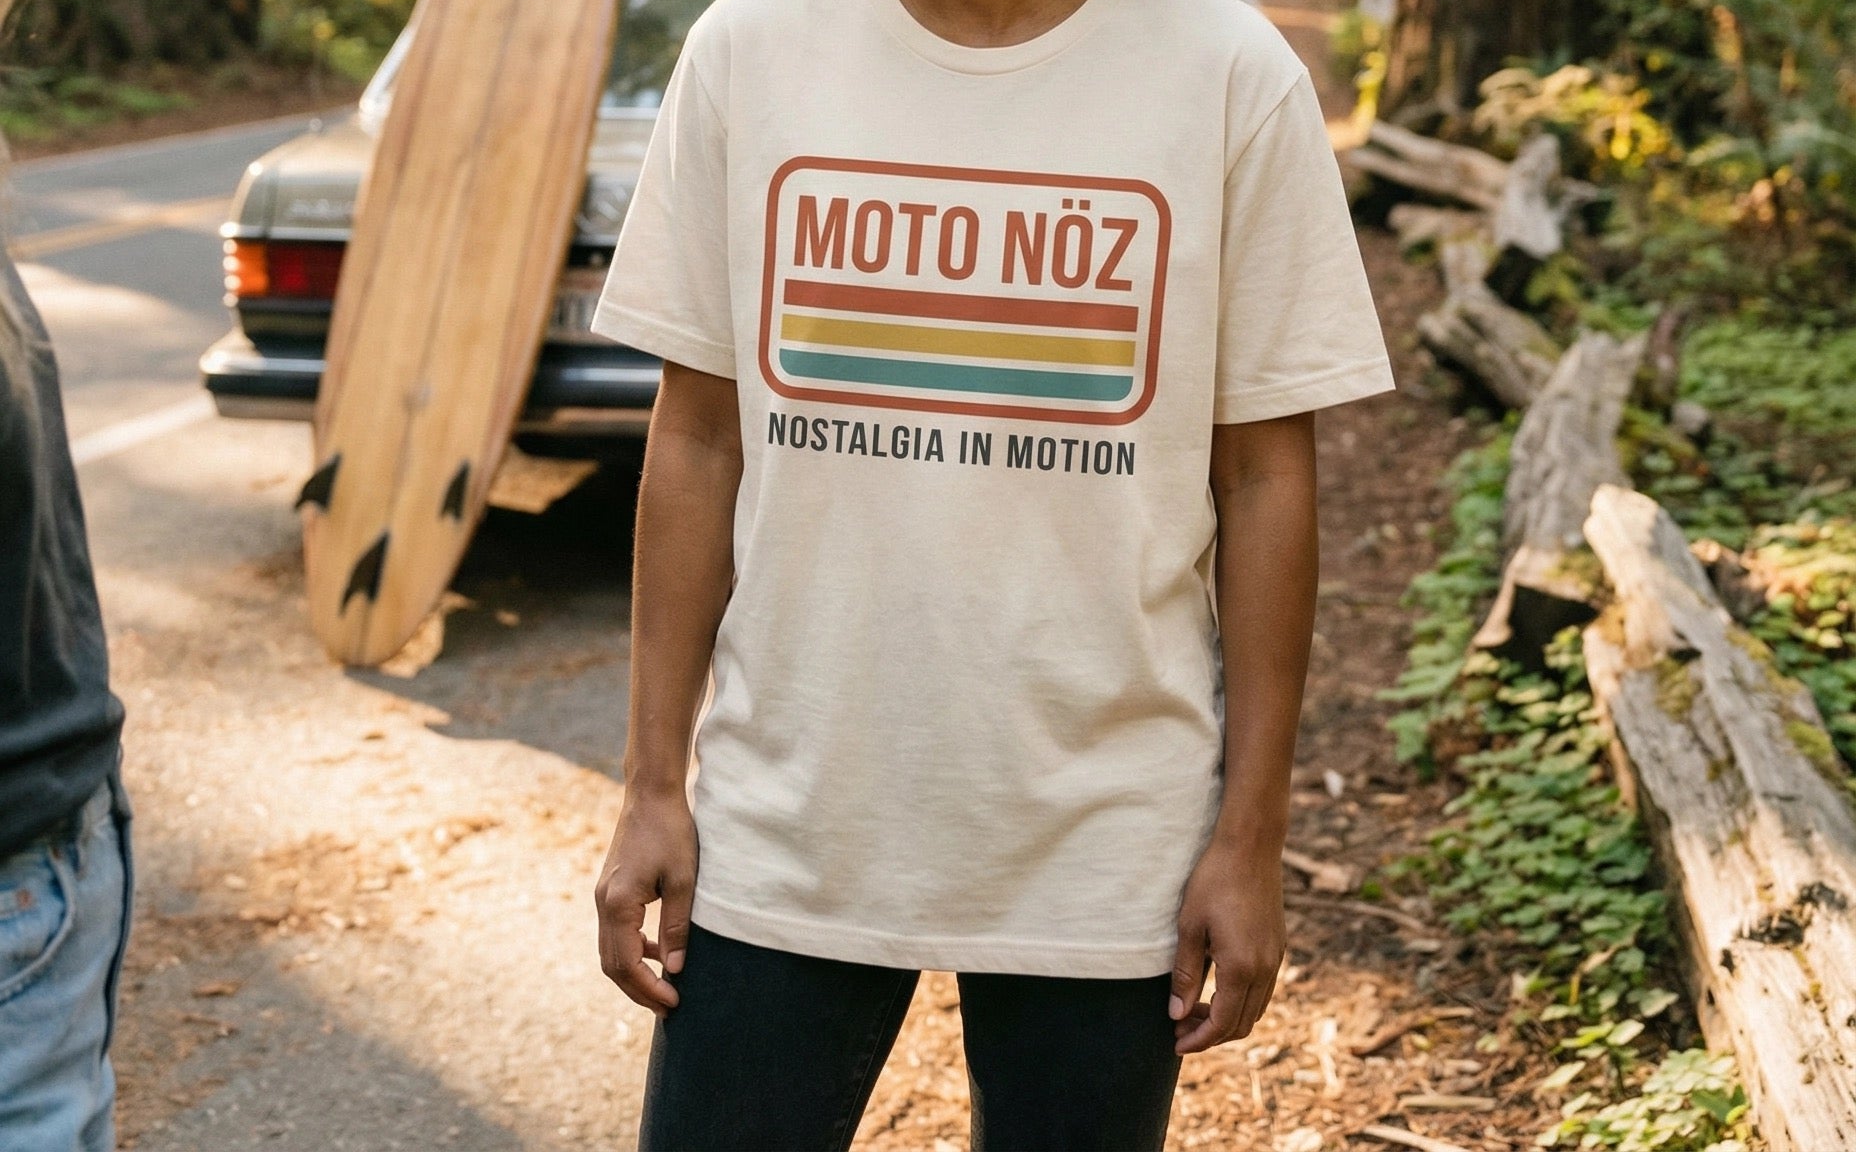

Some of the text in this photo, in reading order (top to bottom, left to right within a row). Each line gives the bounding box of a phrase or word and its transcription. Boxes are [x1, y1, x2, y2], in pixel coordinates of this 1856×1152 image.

[793, 194, 1139, 291] MOTO NÖZ
[768, 412, 1135, 476] NOSTALGIA IN MOTION
